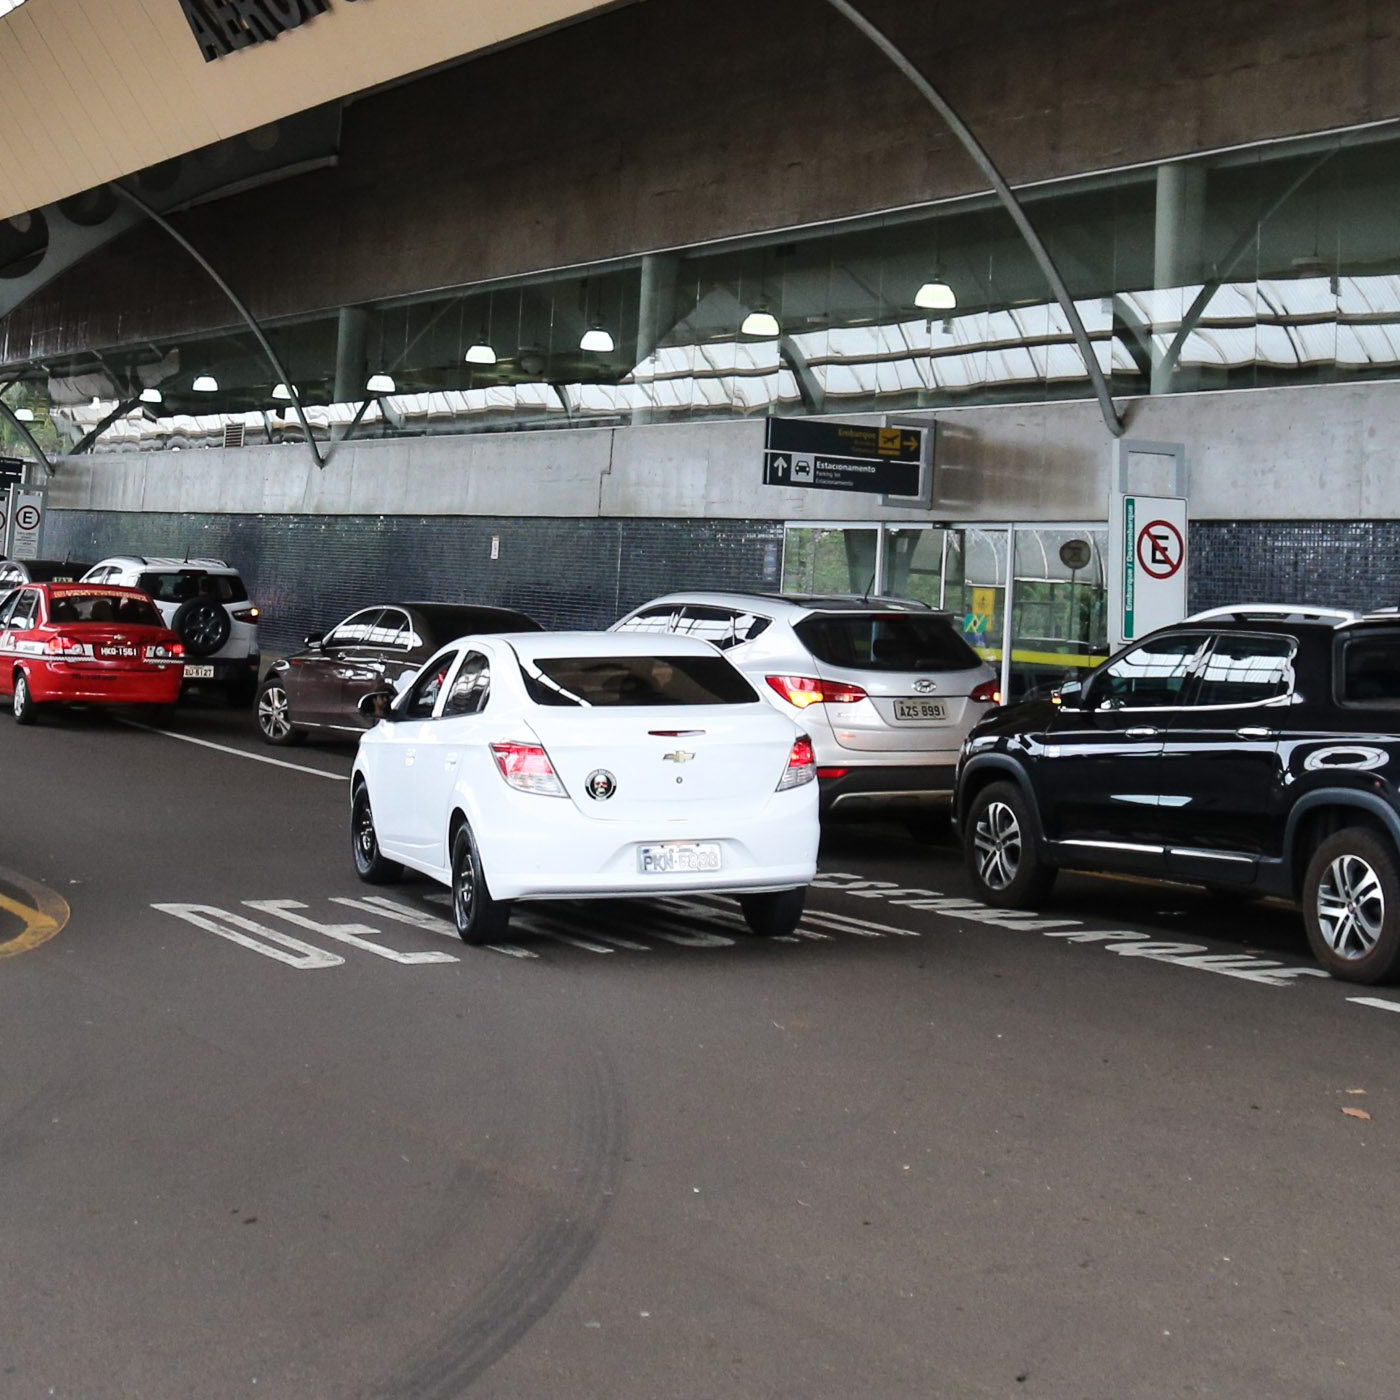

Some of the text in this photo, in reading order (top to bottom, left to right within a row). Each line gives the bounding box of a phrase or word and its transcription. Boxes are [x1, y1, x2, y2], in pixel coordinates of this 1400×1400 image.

[837, 428, 877, 441] Embarque
[816, 461, 876, 474] Estacionamento
[1126, 504, 1135, 562] Desembarque
[1125, 566, 1135, 611] Embarque
